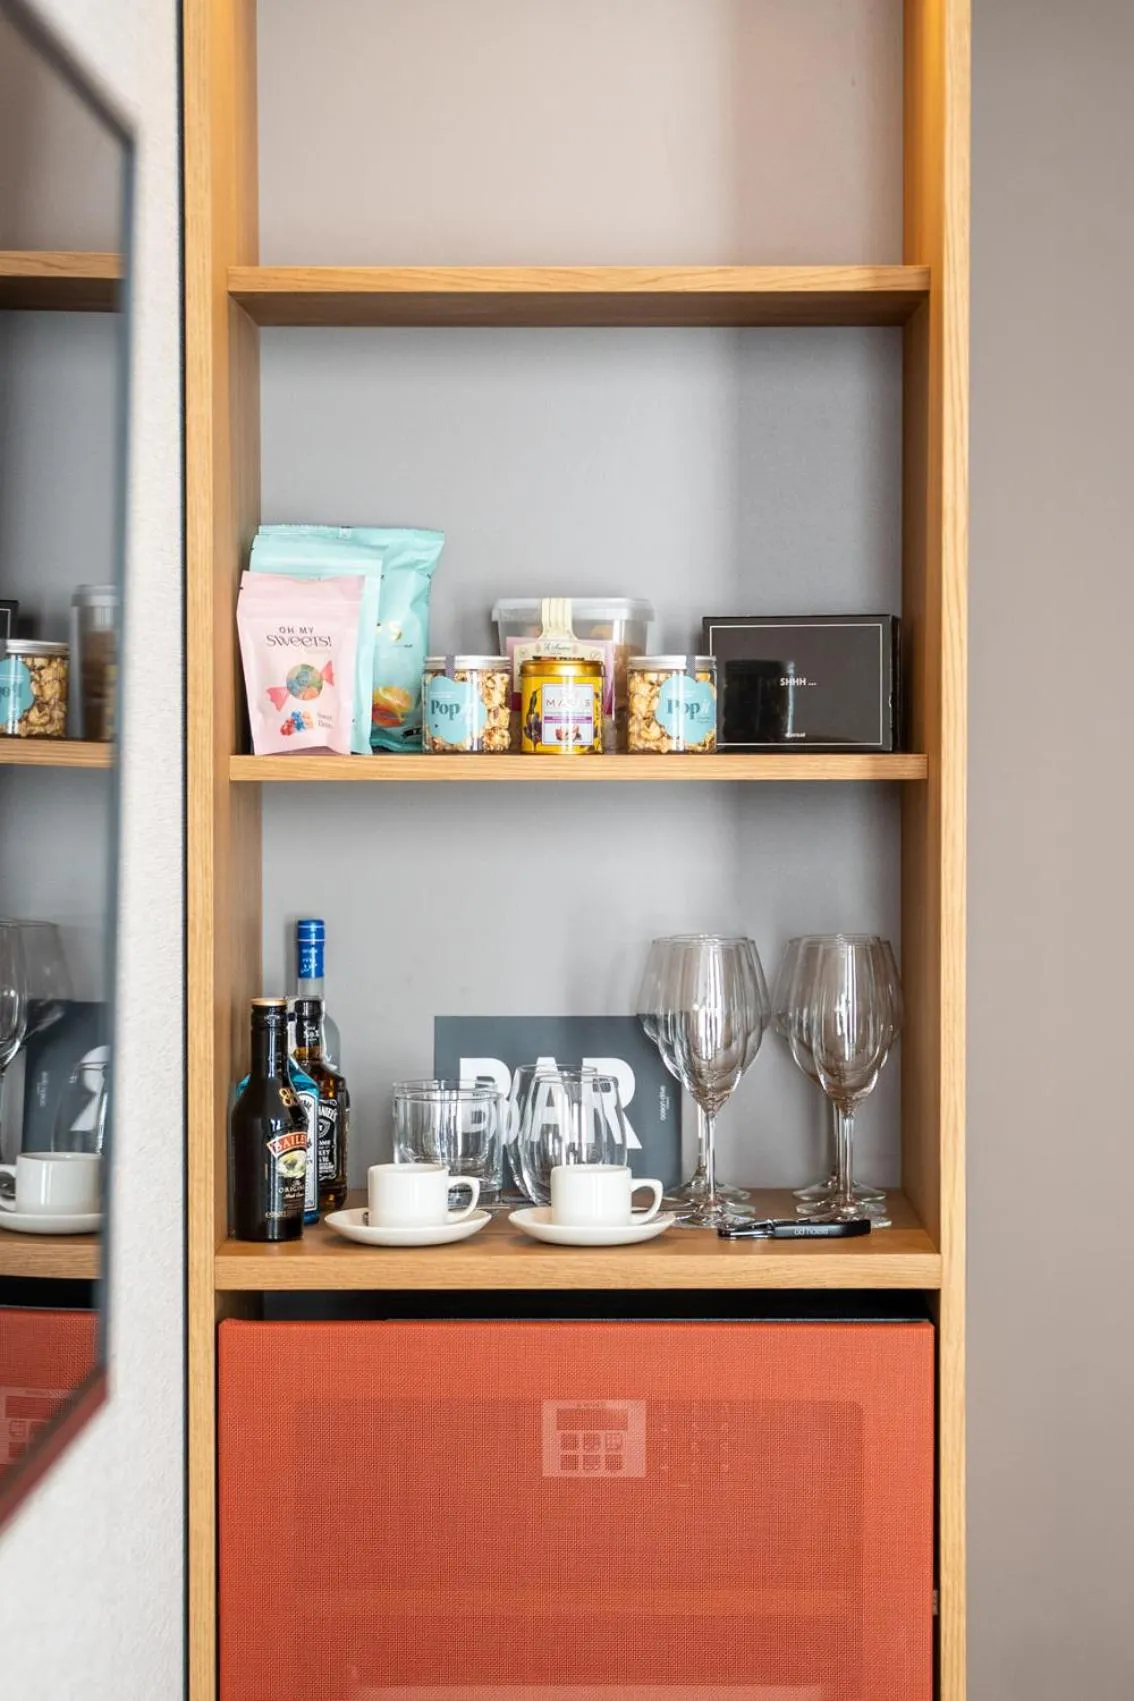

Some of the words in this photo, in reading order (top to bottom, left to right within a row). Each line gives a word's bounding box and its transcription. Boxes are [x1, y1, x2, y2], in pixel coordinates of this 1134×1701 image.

[279, 626, 294, 634] OH
[299, 626, 314, 634] MY
[431, 700, 461, 720] Pop
[459, 1057, 643, 1150] BAR
